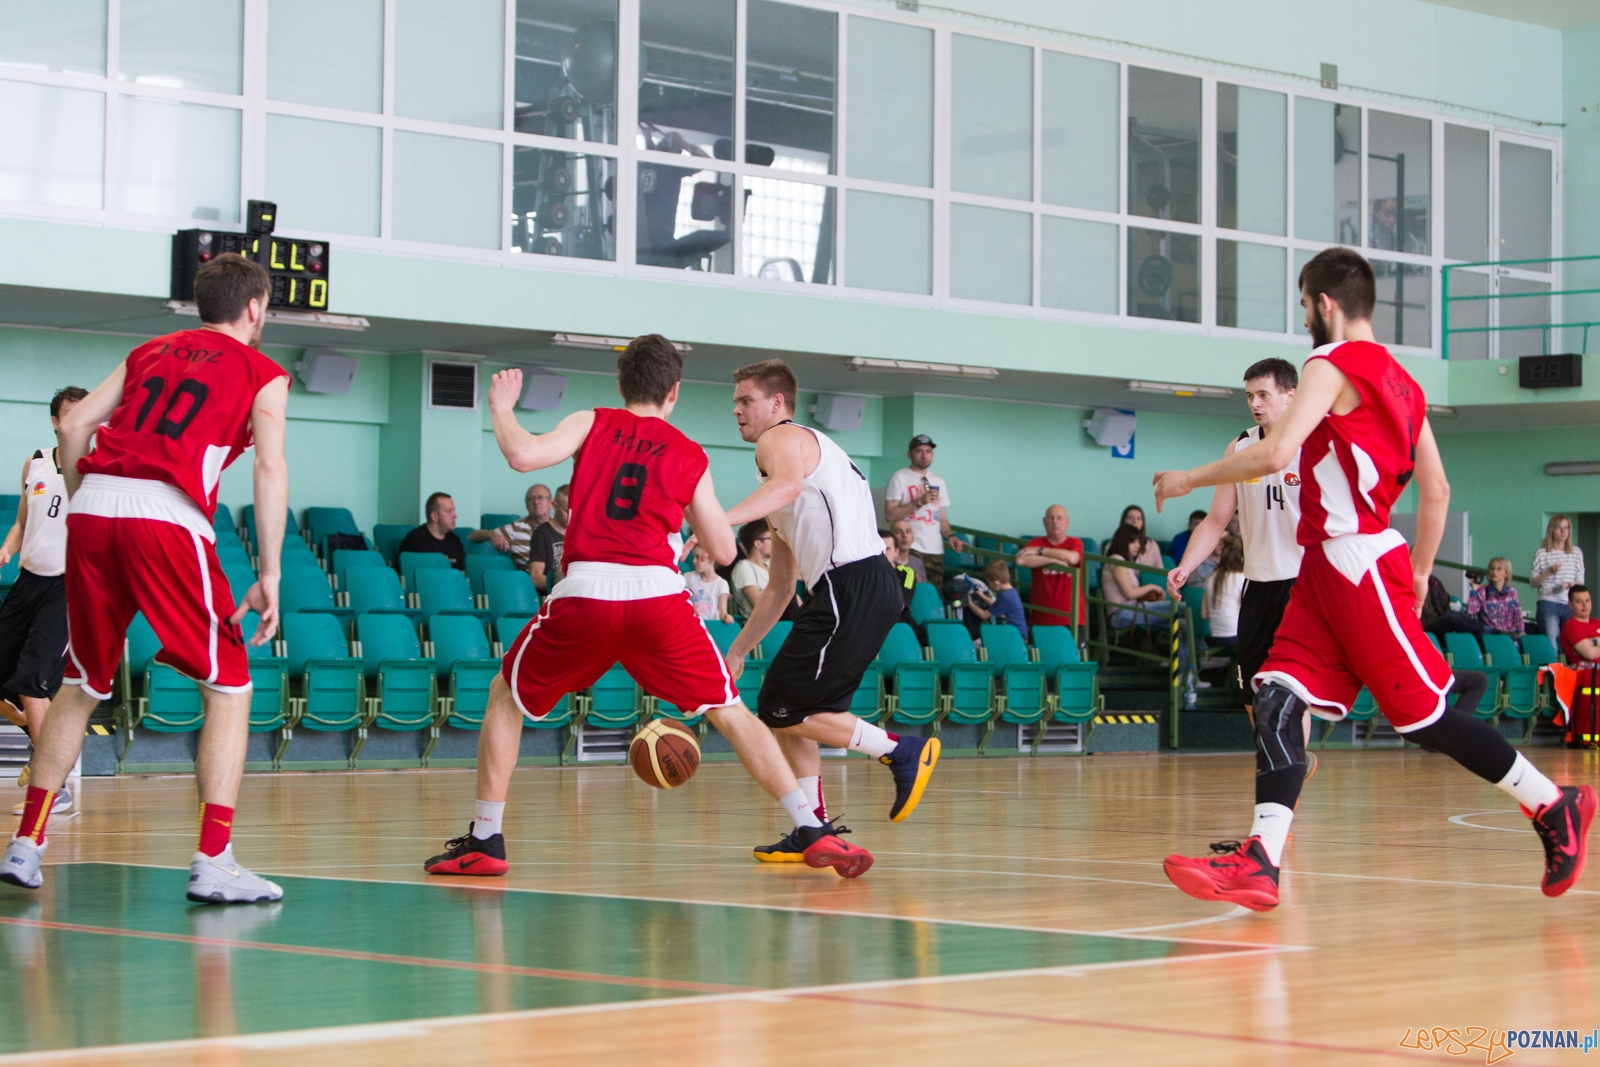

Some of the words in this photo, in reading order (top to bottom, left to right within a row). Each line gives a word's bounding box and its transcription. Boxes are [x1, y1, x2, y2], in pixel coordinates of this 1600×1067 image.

[289, 277, 328, 308] 10
[134, 375, 209, 441] 10
[47, 495, 62, 518] 8
[604, 461, 648, 521] 8
[1266, 483, 1285, 510] 14
